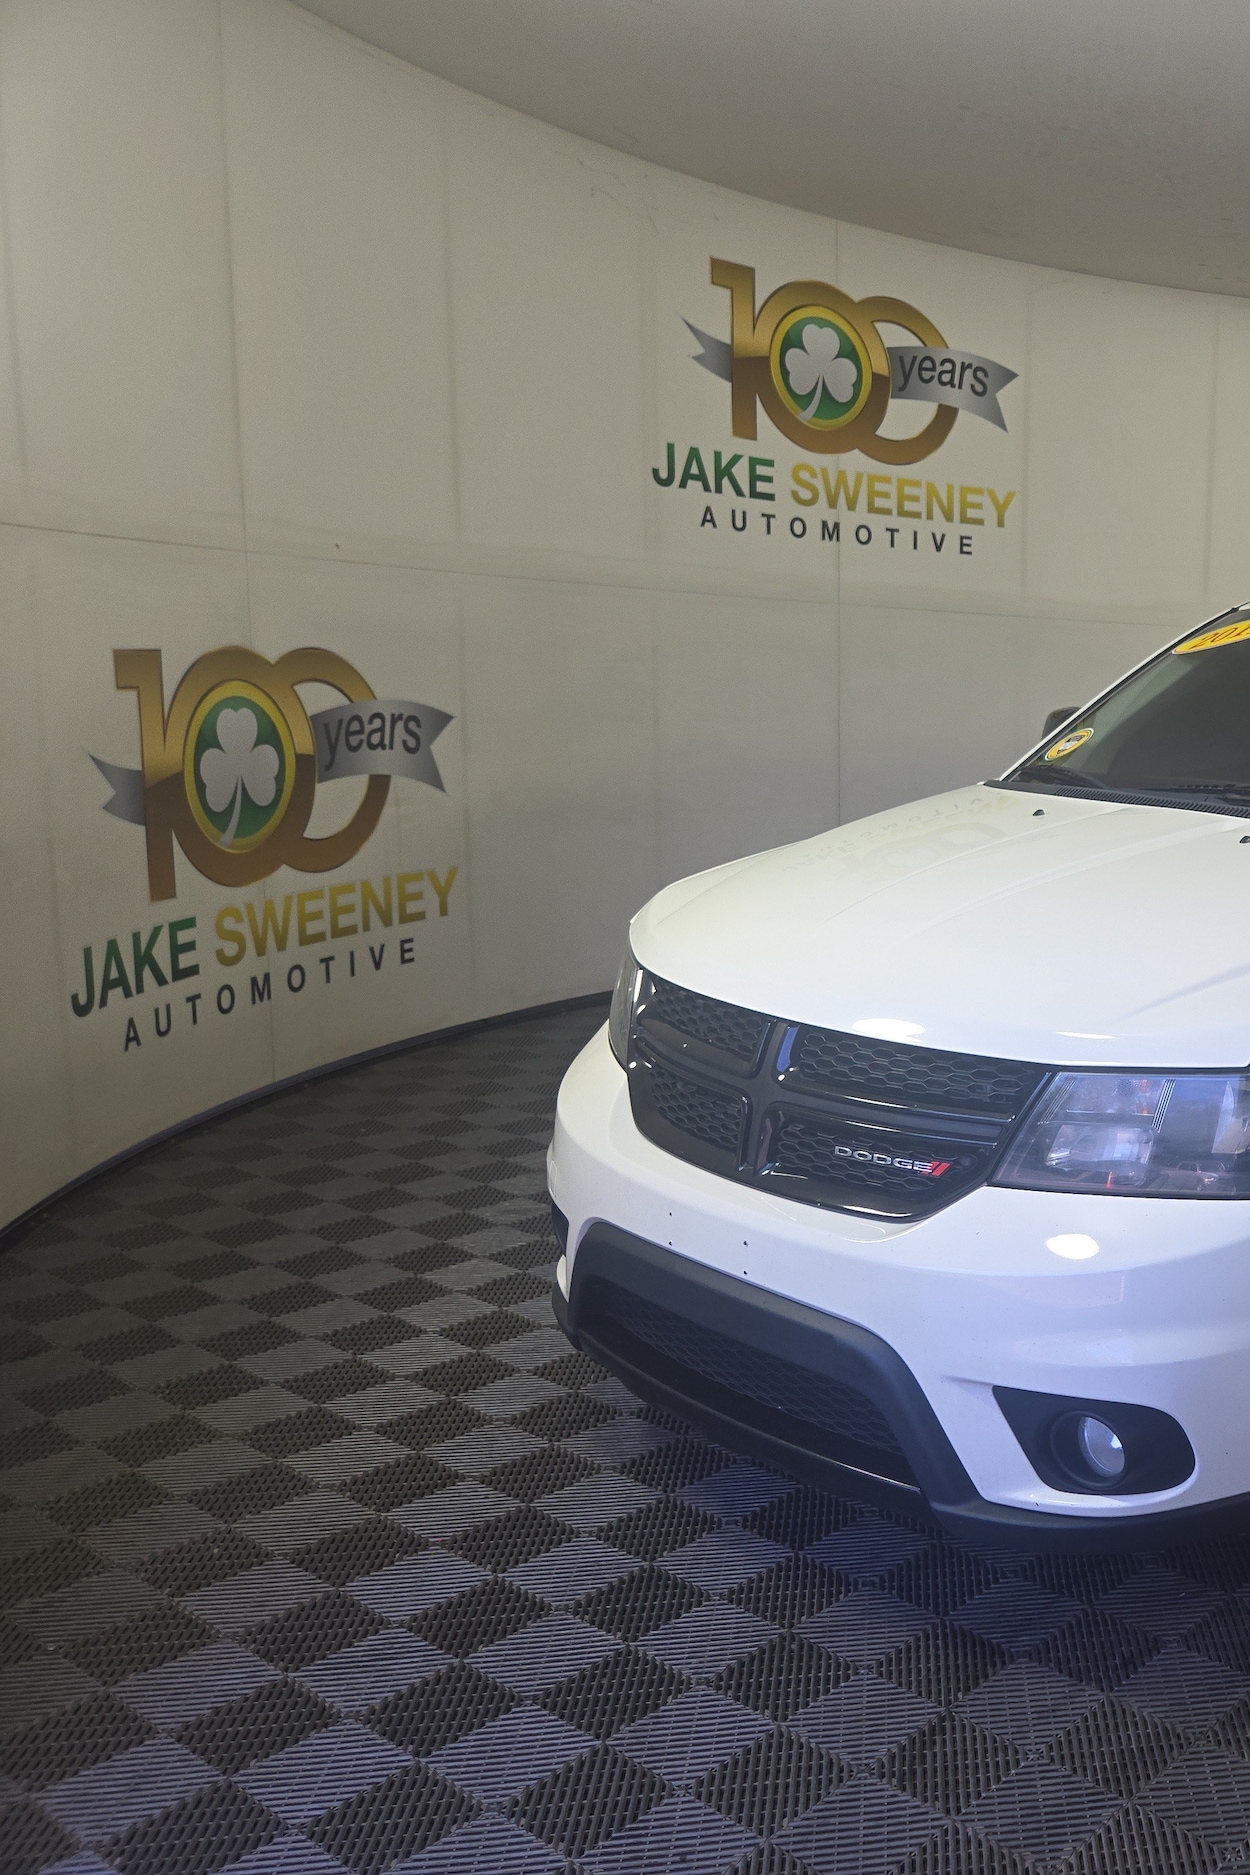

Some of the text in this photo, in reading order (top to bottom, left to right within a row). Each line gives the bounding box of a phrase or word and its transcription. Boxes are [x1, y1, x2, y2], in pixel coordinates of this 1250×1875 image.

[898, 353, 990, 397] years
[652, 442, 1017, 529] JAKE SWEENEY
[700, 506, 974, 556] AUTOMOTIVE
[323, 711, 422, 771] years
[70, 867, 460, 1018] JAKE SWEENEY
[123, 938, 416, 1052] AUTOMOTIVE
[834, 1145, 933, 1173] DODGE
